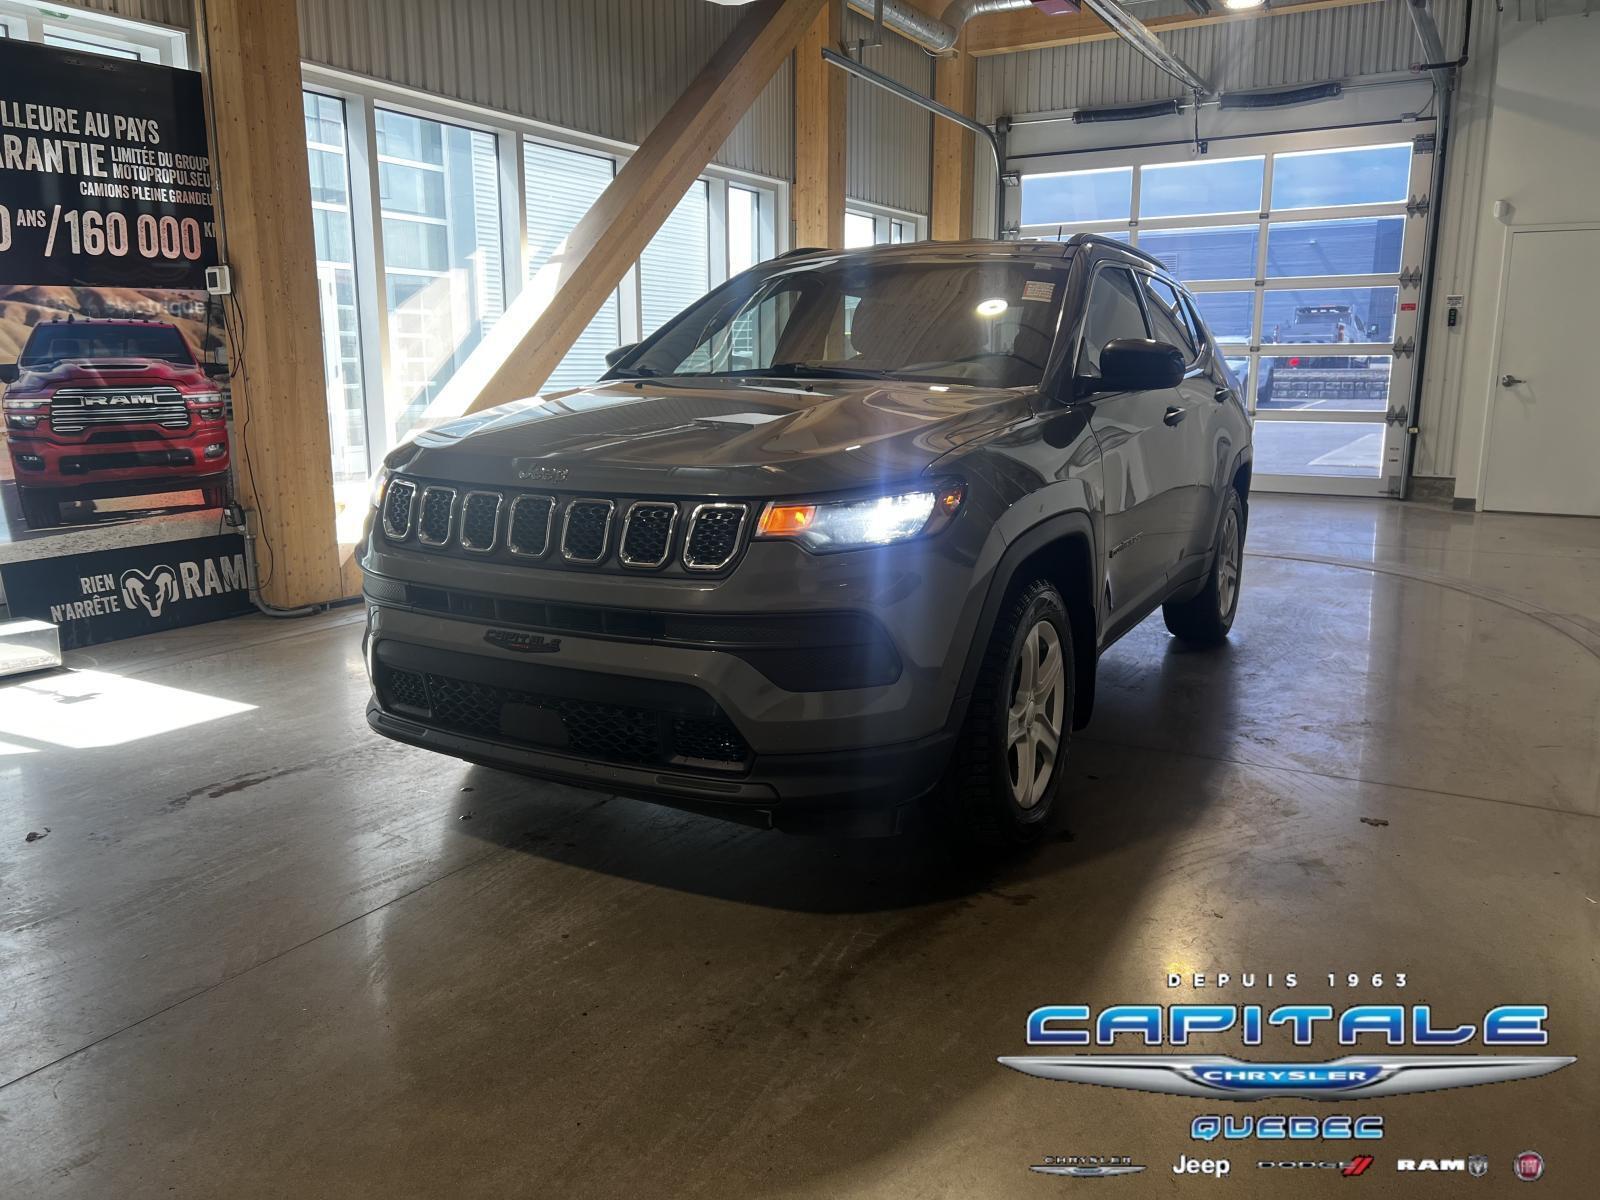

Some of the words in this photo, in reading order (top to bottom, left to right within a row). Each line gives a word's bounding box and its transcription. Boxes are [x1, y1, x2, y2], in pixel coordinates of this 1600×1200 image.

[85, 111, 110, 139] AU
[113, 115, 160, 145] PAYS
[110, 145, 156, 167] LIMITÉE
[157, 151, 173, 168] DU
[79, 181, 130, 199] CAMIONS
[131, 186, 168, 202] PLEINE
[16, 208, 47, 228] ANS
[136, 213, 202, 260] 000
[82, 394, 154, 406] RAM
[80, 573, 115, 595] RIEN
[179, 553, 248, 600] RAM
